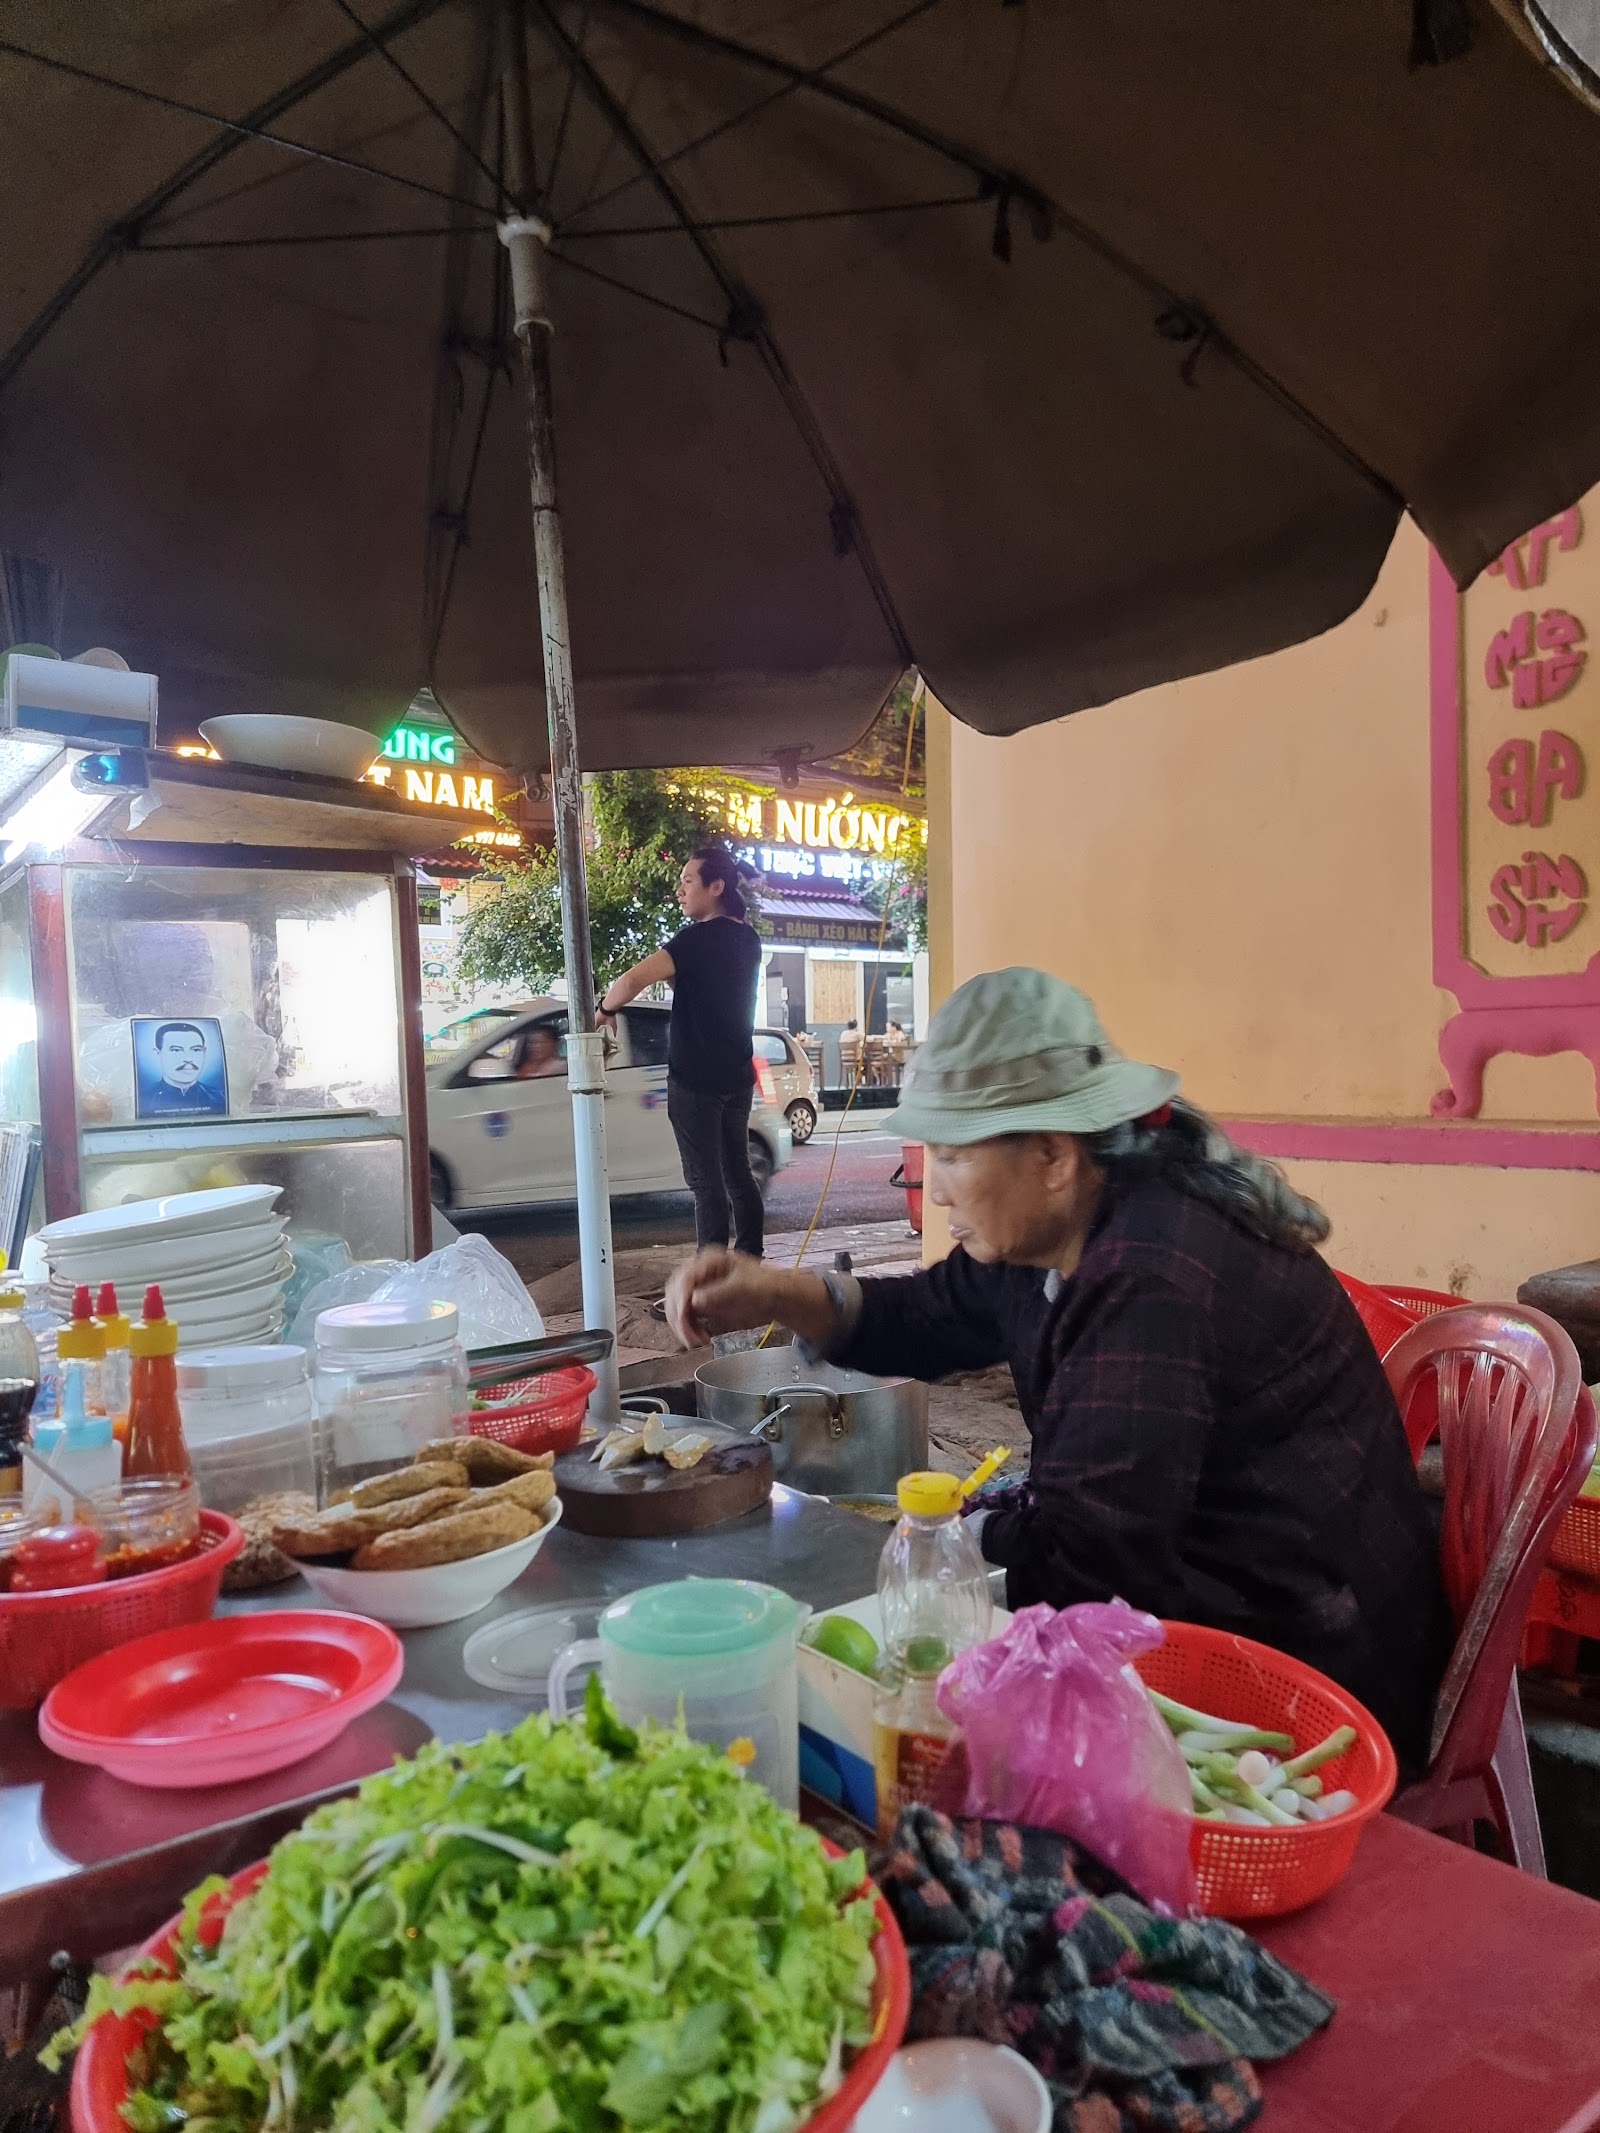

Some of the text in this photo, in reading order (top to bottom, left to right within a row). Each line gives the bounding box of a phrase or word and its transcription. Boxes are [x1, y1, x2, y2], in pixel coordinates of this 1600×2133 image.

[405, 769, 495, 815] NAM
[1487, 729, 1584, 828] BA
[786, 920, 819, 938] BÁNH
[822, 921, 845, 940] XÈO
